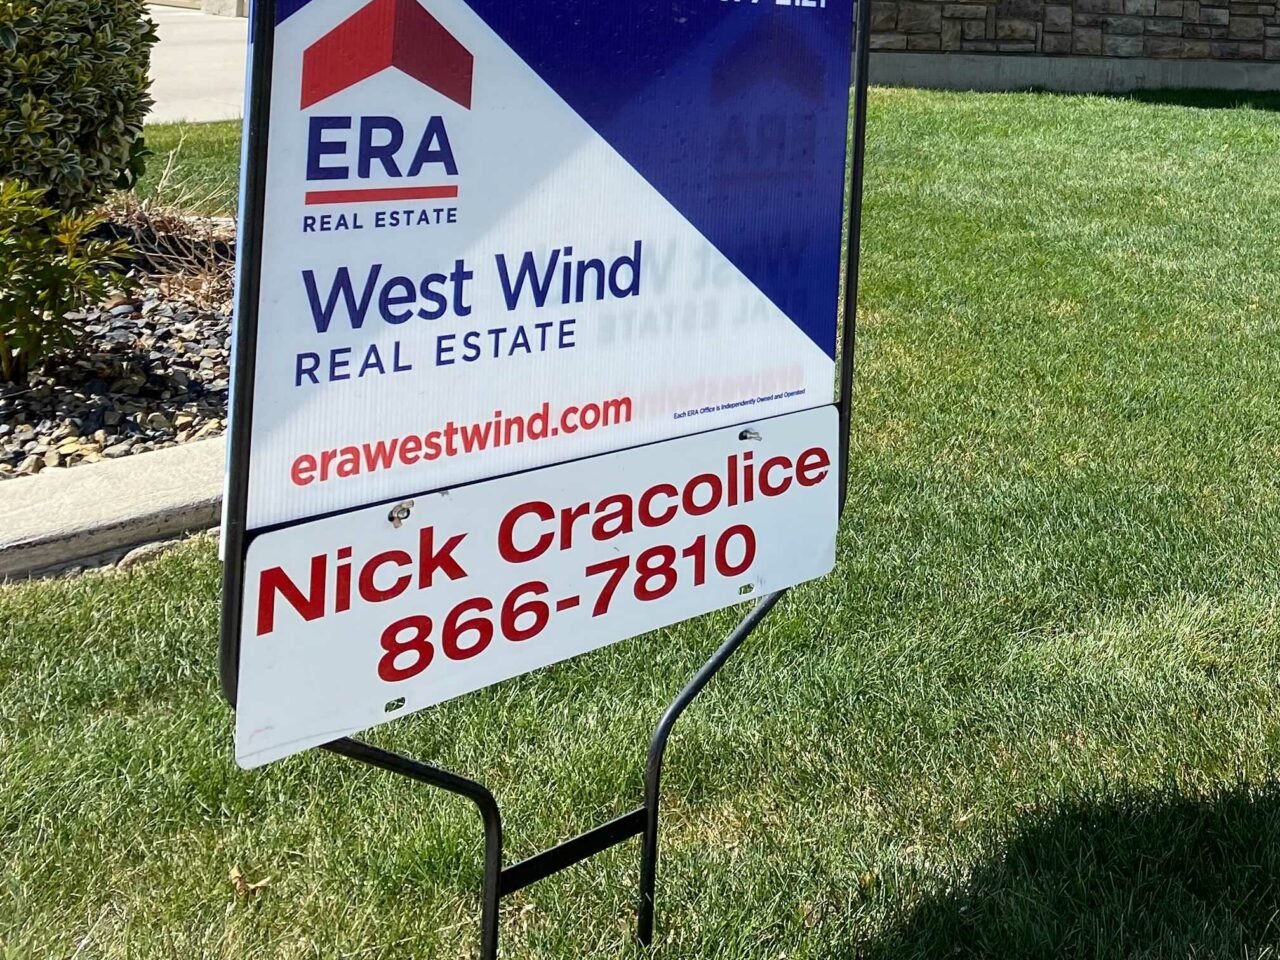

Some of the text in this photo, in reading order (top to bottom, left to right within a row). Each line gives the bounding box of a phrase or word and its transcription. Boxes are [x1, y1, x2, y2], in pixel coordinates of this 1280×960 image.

[305, 115, 459, 182] ERA
[303, 207, 458, 233] REAL ESTATE
[301, 259, 474, 334] West
[494, 239, 642, 311] Wind
[296, 318, 577, 387] REAL ESTATE
[290, 395, 633, 487] erawestwind.com
[673, 411, 687, 419] Each
[687, 409, 699, 417] ERA
[699, 406, 715, 414] Office
[721, 399, 756, 410] Independently
[756, 394, 774, 403] Owned
[774, 392, 784, 400] and
[256, 444, 831, 637] Nick Cracolice
[377, 524, 756, 683] 866-7810
